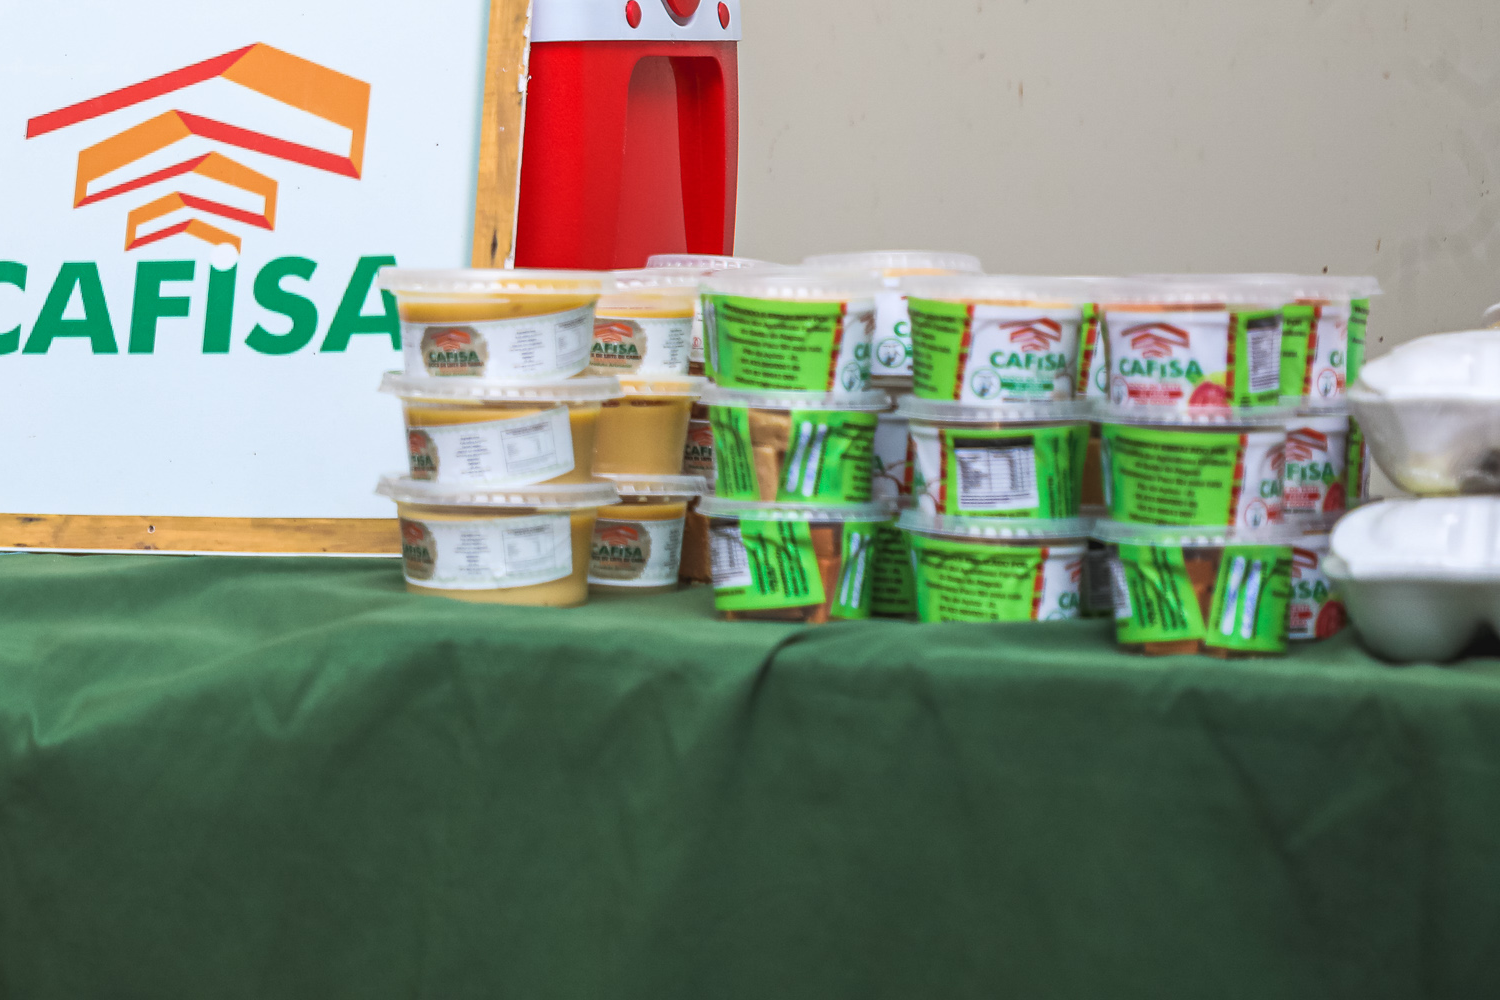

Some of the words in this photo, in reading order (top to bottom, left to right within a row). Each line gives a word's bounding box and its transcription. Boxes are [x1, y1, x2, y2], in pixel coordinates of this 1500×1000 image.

[429, 350, 480, 363] CAFISA
[591, 342, 639, 355] AFISA
[1119, 358, 1203, 379] CAFISA
[1286, 462, 1335, 481] FISA
